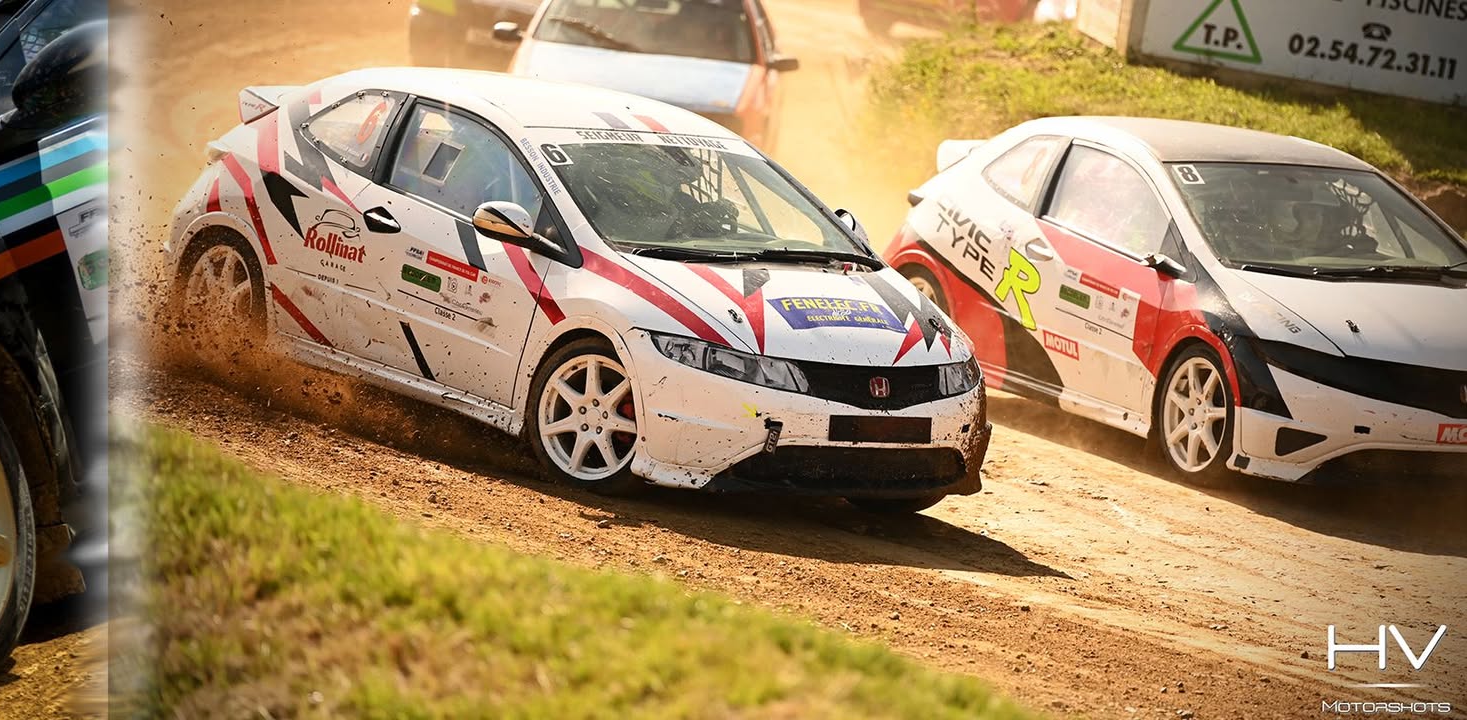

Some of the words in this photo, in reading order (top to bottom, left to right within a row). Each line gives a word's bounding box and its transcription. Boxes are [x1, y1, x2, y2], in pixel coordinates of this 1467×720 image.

[1204, 24, 1243, 49] T.P.
[1288, 34, 1457, 80] 02.54.72.31.11
[520, 138, 538, 162] BESSON
[537, 162, 561, 195] INDUSTRIE
[540, 143, 568, 164] 6
[1177, 166, 1199, 182] 8
[303, 226, 366, 264] Rollinat
[937, 213, 996, 282] TYPE
[994, 247, 1042, 331] R
[435, 307, 452, 320] Classe
[452, 313, 457, 321] 2
[1045, 332, 1079, 357] MOTUL
